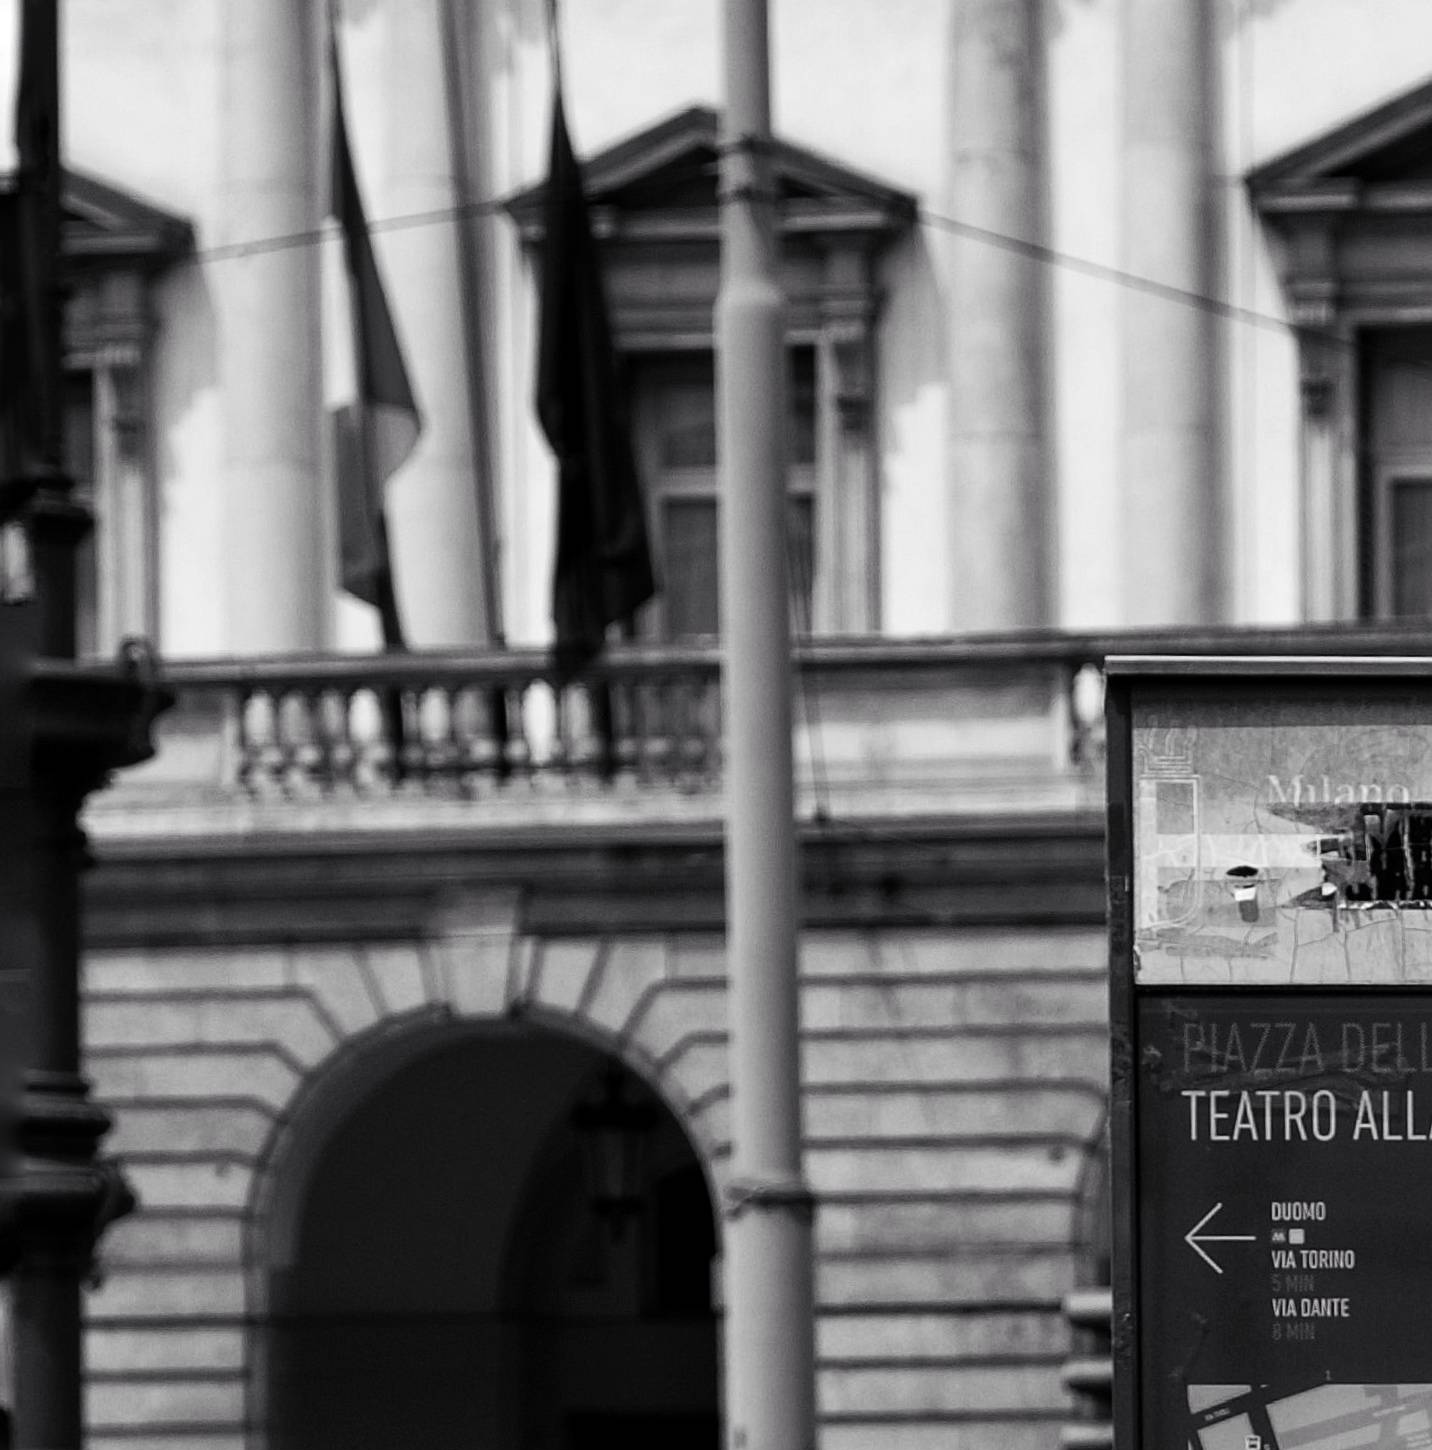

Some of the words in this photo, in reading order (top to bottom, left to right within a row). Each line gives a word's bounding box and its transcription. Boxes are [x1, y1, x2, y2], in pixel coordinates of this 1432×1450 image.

[1183, 1022, 1325, 1072] PIAZZA
[1181, 1089, 1336, 1141] TEATRO
[1271, 1201, 1326, 1221] DUOMO
[1271, 1250, 1297, 1269] VIA
[1299, 1249, 1355, 1269] TORINO
[1286, 1274, 1314, 1292] MIN
[1272, 1298, 1297, 1317] VIA
[1300, 1298, 1350, 1317] DANTE
[1286, 1322, 1315, 1340] MIN
